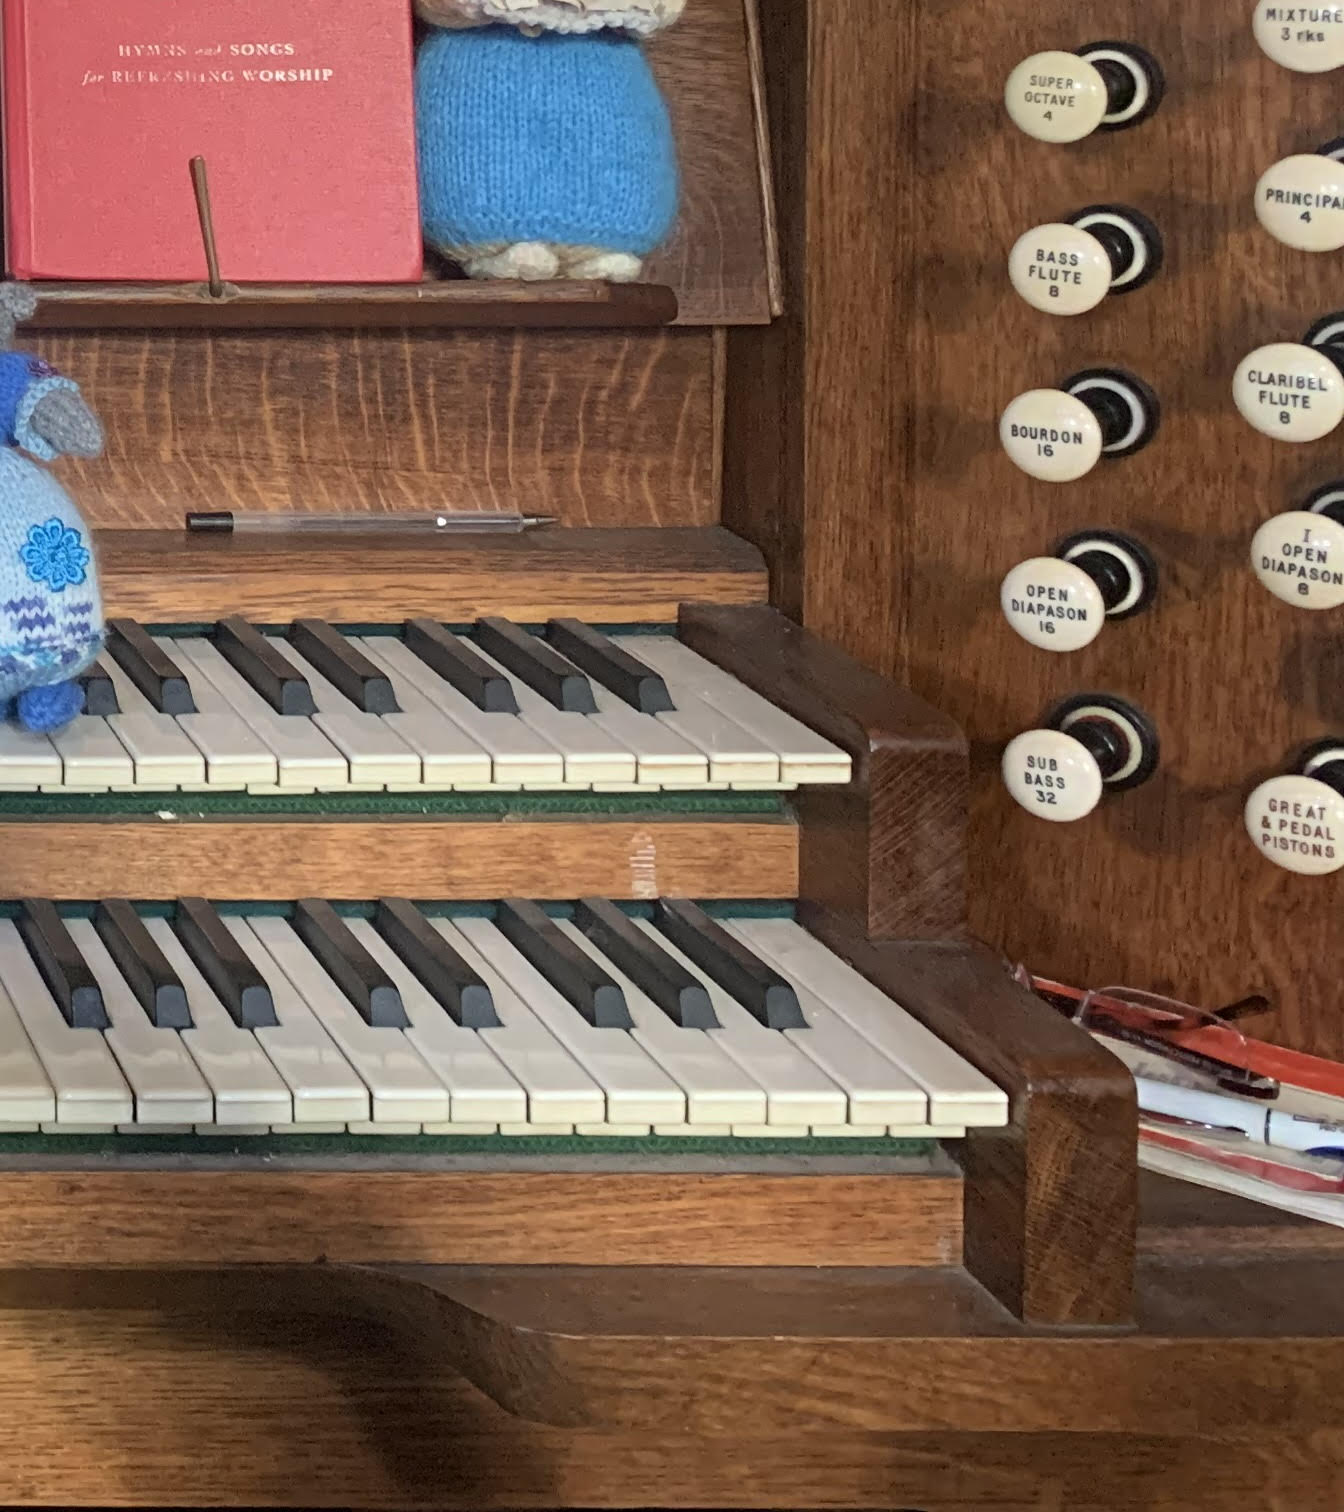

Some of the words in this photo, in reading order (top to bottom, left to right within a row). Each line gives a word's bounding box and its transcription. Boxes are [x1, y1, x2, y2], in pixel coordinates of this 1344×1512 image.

[1265, 7, 1344, 24] MIXTURE
[1280, 27, 1291, 42] 3
[229, 43, 296, 57] SONGS
[242, 68, 334, 83] WORSHIP
[1029, 74, 1074, 90] SUPER
[1024, 91, 1076, 108] OCTAVE
[1042, 110, 1053, 122] 4
[1299, 210, 1312, 224] 4
[1035, 248, 1080, 267] BASS
[1028, 265, 1082, 285] FLUTE
[1048, 285, 1060, 299] 8
[1247, 369, 1328, 392] CLARIBEL
[1258, 390, 1311, 409] FLUTE
[1279, 411, 1291, 425] 8
[1010, 423, 1083, 445] BOURDON
[1037, 443, 1054, 457] 16
[1282, 543, 1328, 563] OPEN
[1261, 556, 1344, 585] DIAPASON
[1026, 584, 1069, 602] OPEN
[1297, 582, 1310, 596] 8
[1011, 599, 1088, 621] DIAPASON
[1039, 621, 1056, 635] 16
[1026, 754, 1058, 772] SUB
[1024, 771, 1066, 789] BASS
[1035, 790, 1058, 805] 32
[1268, 798, 1327, 821] GREAT
[1261, 815, 1272, 830] &
[1278, 819, 1336, 841] PEDAL
[1261, 833, 1335, 859] PISTONS
